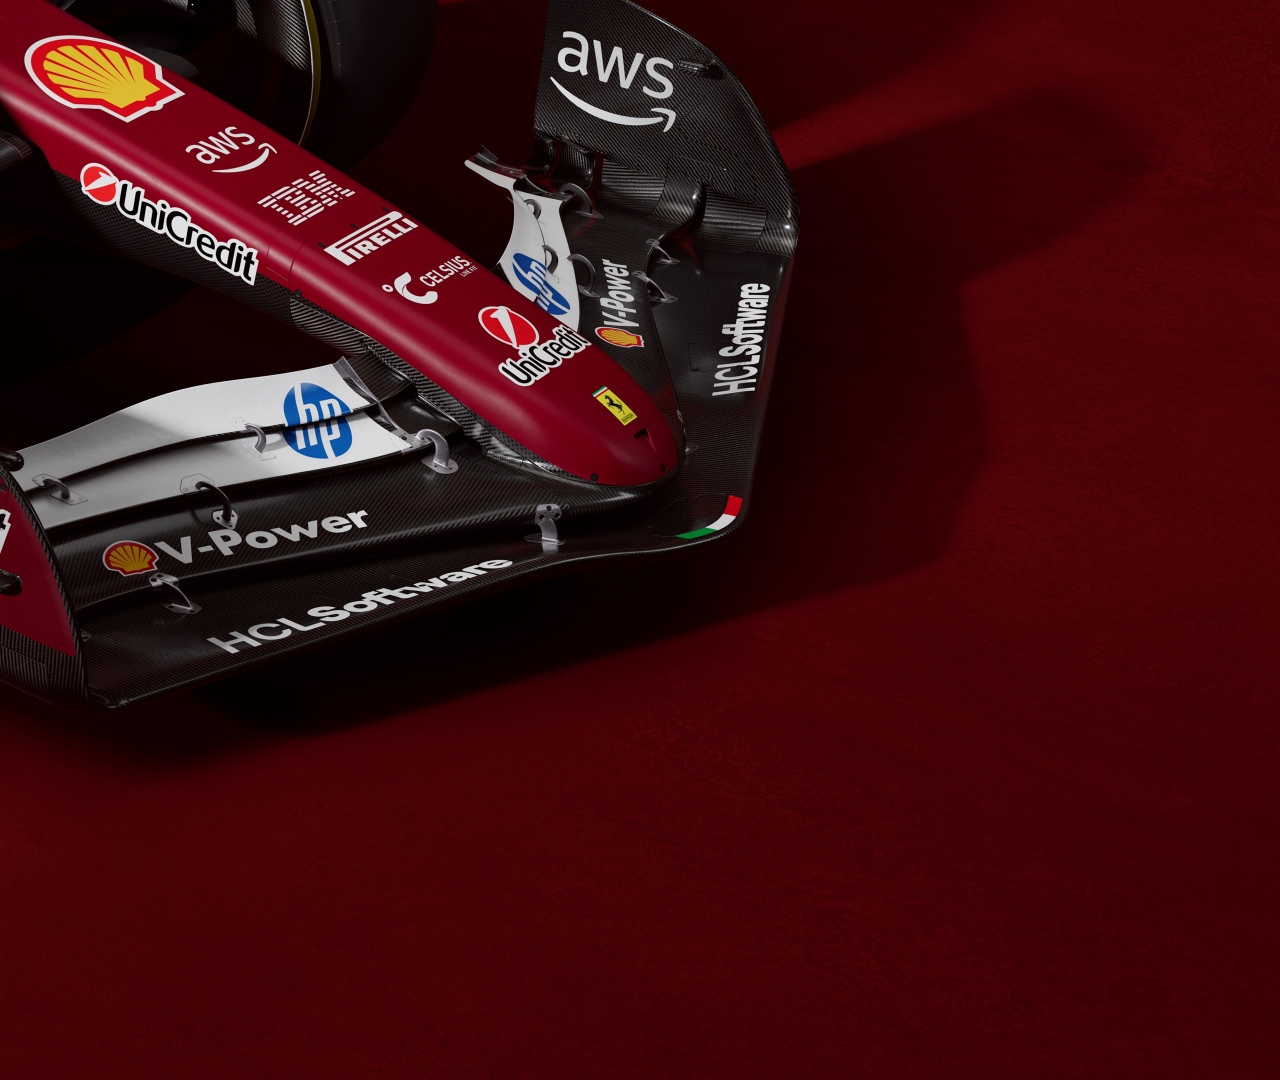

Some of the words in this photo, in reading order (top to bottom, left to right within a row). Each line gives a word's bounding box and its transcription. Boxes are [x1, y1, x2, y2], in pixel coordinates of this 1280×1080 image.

[557, 30, 674, 99] aws
[184, 125, 256, 166] aws
[256, 169, 356, 227] IBM
[118, 182, 259, 282] UniCredit
[323, 210, 419, 266] PIRELLI
[419, 255, 471, 287] CELSIUS
[602, 259, 640, 328] V-Power
[501, 325, 589, 385] UniCredit
[712, 282, 771, 397] HCLSoftware
[293, 382, 342, 459] hp
[154, 507, 369, 565] V-Power
[207, 556, 513, 655] HCLSoftware
